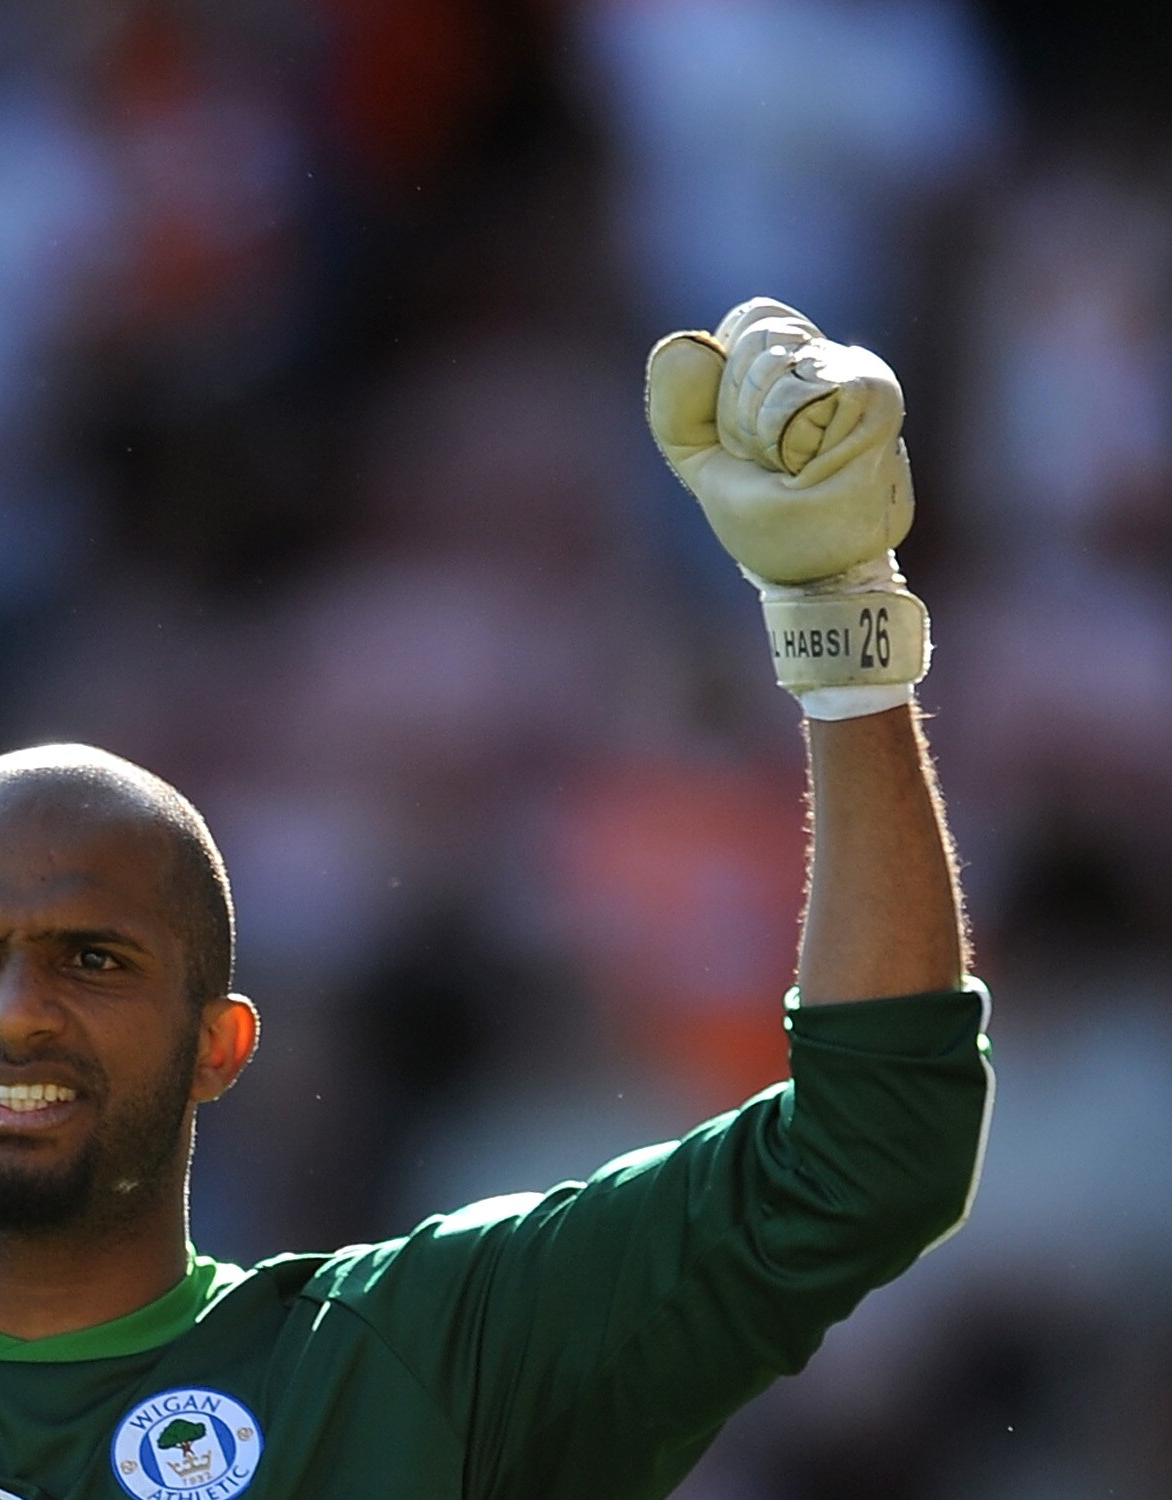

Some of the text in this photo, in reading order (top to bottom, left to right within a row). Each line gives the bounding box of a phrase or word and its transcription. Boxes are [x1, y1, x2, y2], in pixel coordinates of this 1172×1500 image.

[784, 628, 851, 659] HABSI
[859, 606, 891, 669] 26
[129, 1394, 223, 1431] WIGAN
